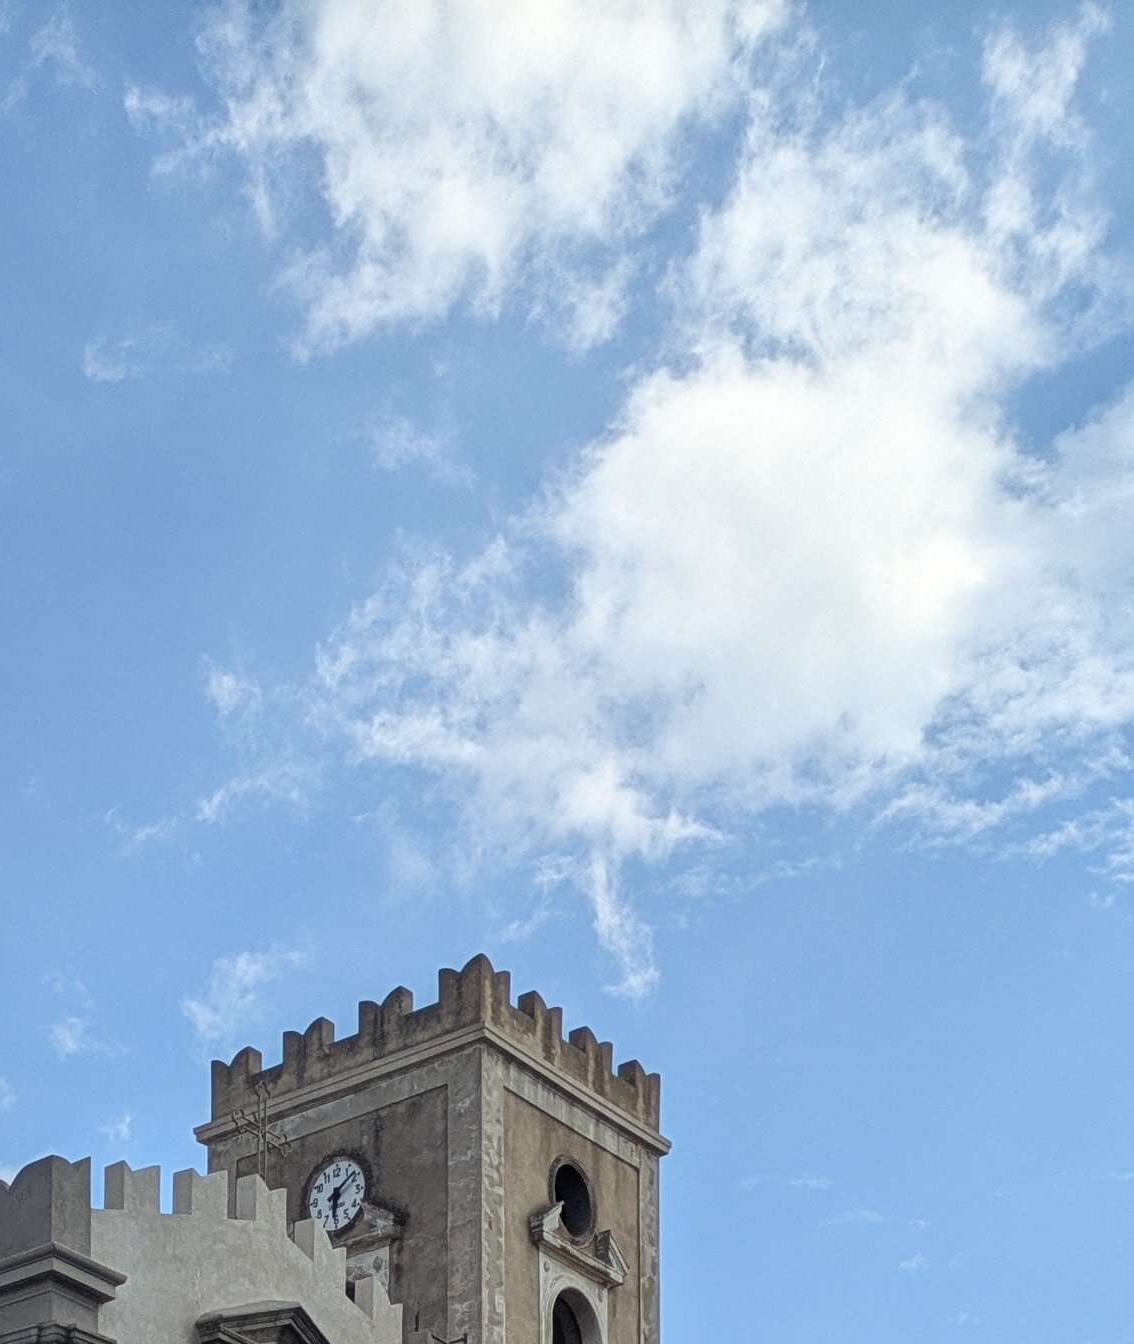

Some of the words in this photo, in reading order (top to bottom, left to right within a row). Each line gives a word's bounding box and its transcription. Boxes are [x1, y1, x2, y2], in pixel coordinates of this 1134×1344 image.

[333, 1167, 341, 1178] 12
[324, 1174, 330, 1184] 11
[316, 1184, 323, 1194] 10
[355, 1184, 360, 1194] 3
[312, 1198, 318, 1208] 9
[351, 1199, 357, 1208] 4
[317, 1209, 322, 1219] 8
[344, 1209, 349, 1219] 5
[324, 1215, 329, 1226] 7
[333, 1214, 339, 1225] 6
